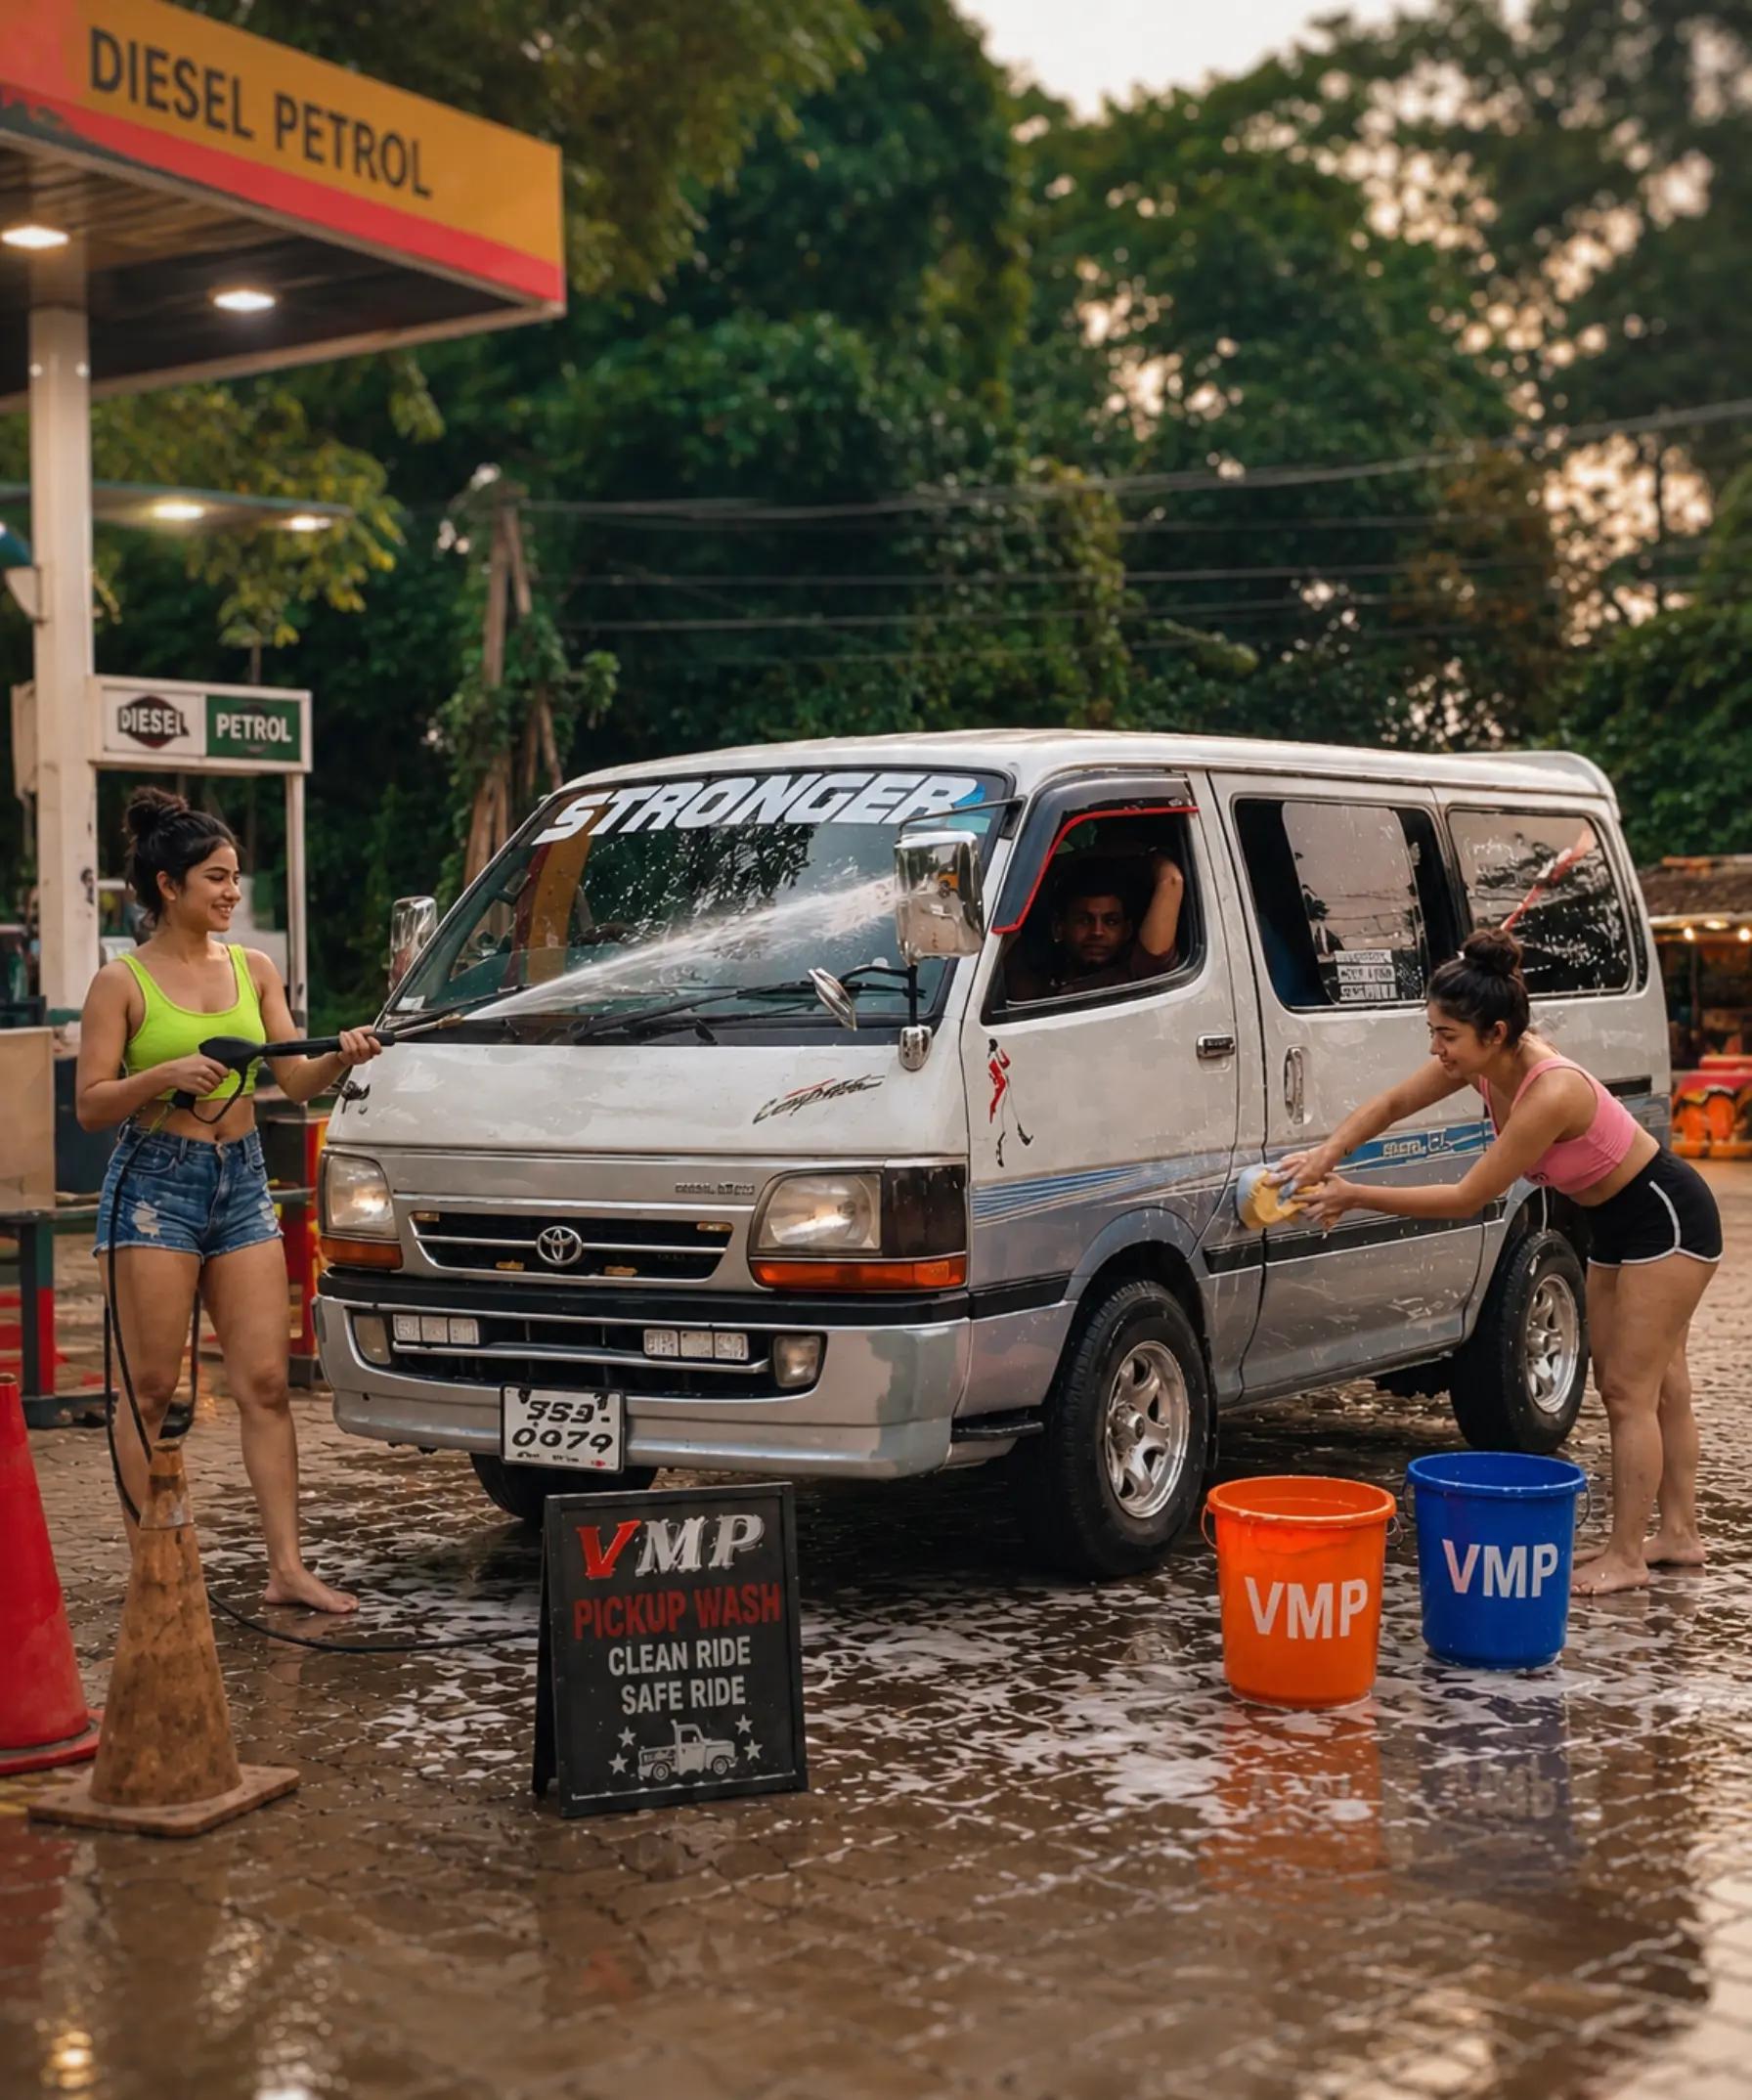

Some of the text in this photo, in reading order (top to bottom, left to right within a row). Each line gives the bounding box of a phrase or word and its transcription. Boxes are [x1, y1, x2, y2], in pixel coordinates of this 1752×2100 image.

[90, 26, 433, 199] DIESEL PETROL
[119, 707, 186, 736] DIESEL
[215, 712, 292, 743] PETROL
[531, 772, 978, 846] STRONGER
[511, 1427, 614, 1454] 0079
[576, 1514, 766, 1580] VMP
[1442, 1539, 1559, 1598] VMP
[573, 1583, 781, 1641] PICKUP WASH
[1244, 1576, 1369, 1640] VMP
[608, 1636, 752, 1676] CLEAN RIDE
[621, 1676, 746, 1715] SAFE RIDE
